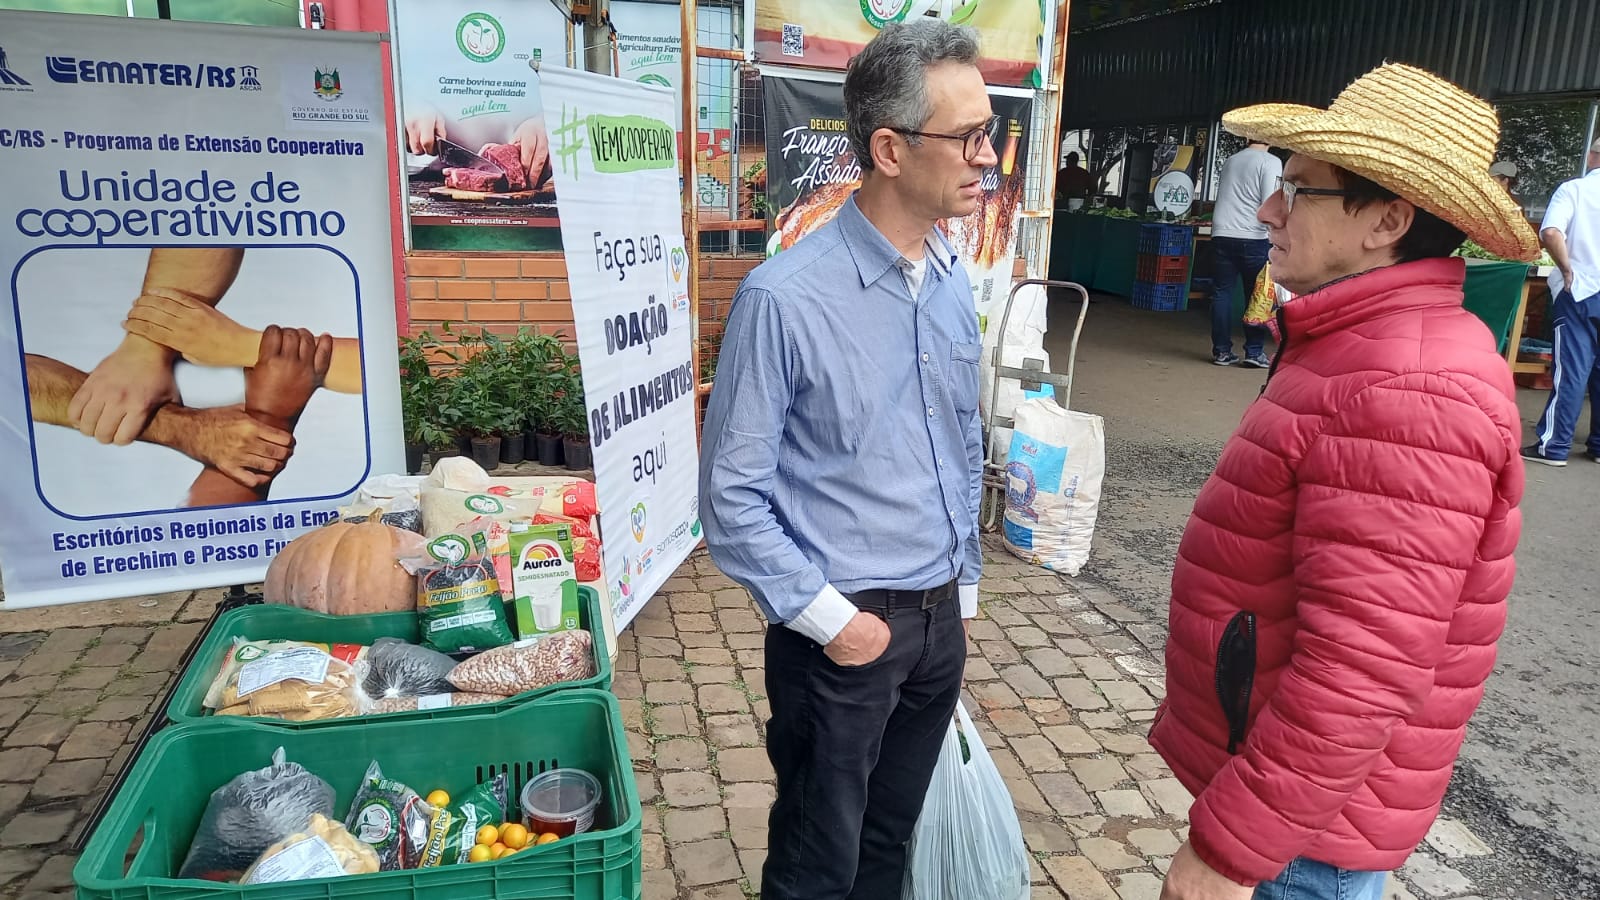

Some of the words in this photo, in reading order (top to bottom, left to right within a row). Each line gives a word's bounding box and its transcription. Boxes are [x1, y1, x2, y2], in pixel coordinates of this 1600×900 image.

[618, 43, 663, 52] Agricultura
[631, 52, 654, 68] aqui
[656, 51, 674, 62] tem
[439, 76, 465, 85] Carne
[466, 77, 496, 87] bovina
[503, 79, 526, 88] suína
[440, 86, 451, 94] da
[453, 87, 484, 96] melhor
[484, 88, 526, 97] qualidade
[308, 112, 341, 120] GRANDE
[462, 101, 486, 117] aqui
[488, 100, 507, 111] tem
[810, 118, 848, 131] DELICIOS
[64, 131, 153, 151] Programa
[158, 133, 179, 150] de
[185, 134, 262, 153] Extensão
[267, 136, 364, 157] Cooperativa
[781, 125, 850, 165] Frango
[791, 156, 862, 190] Assado
[59, 169, 236, 202] Unidade
[250, 171, 300, 203] de
[16, 201, 346, 244] cooperativismo
[450, 217, 528, 226] www.coopnossaterra.com.br
[593, 231, 636, 281] Faça
[640, 233, 662, 264] sua
[604, 294, 669, 356] DOAÇÃO
[591, 400, 611, 448] DE
[614, 360, 693, 435] ALIMENTOS
[632, 431, 667, 485] aqui
[53, 522, 163, 551] Escritórios
[169, 512, 267, 539] Regionais
[272, 512, 295, 530] da
[61, 559, 87, 578] de
[94, 549, 177, 575] Erechim
[184, 546, 196, 565] e
[202, 539, 259, 564] Passo
[265, 538, 293, 557] Fu
[523, 557, 563, 571] Aurora
[518, 570, 570, 582] SEMIDESNATADO
[428, 591, 459, 604] Feijão
[460, 584, 488, 599] Preto
